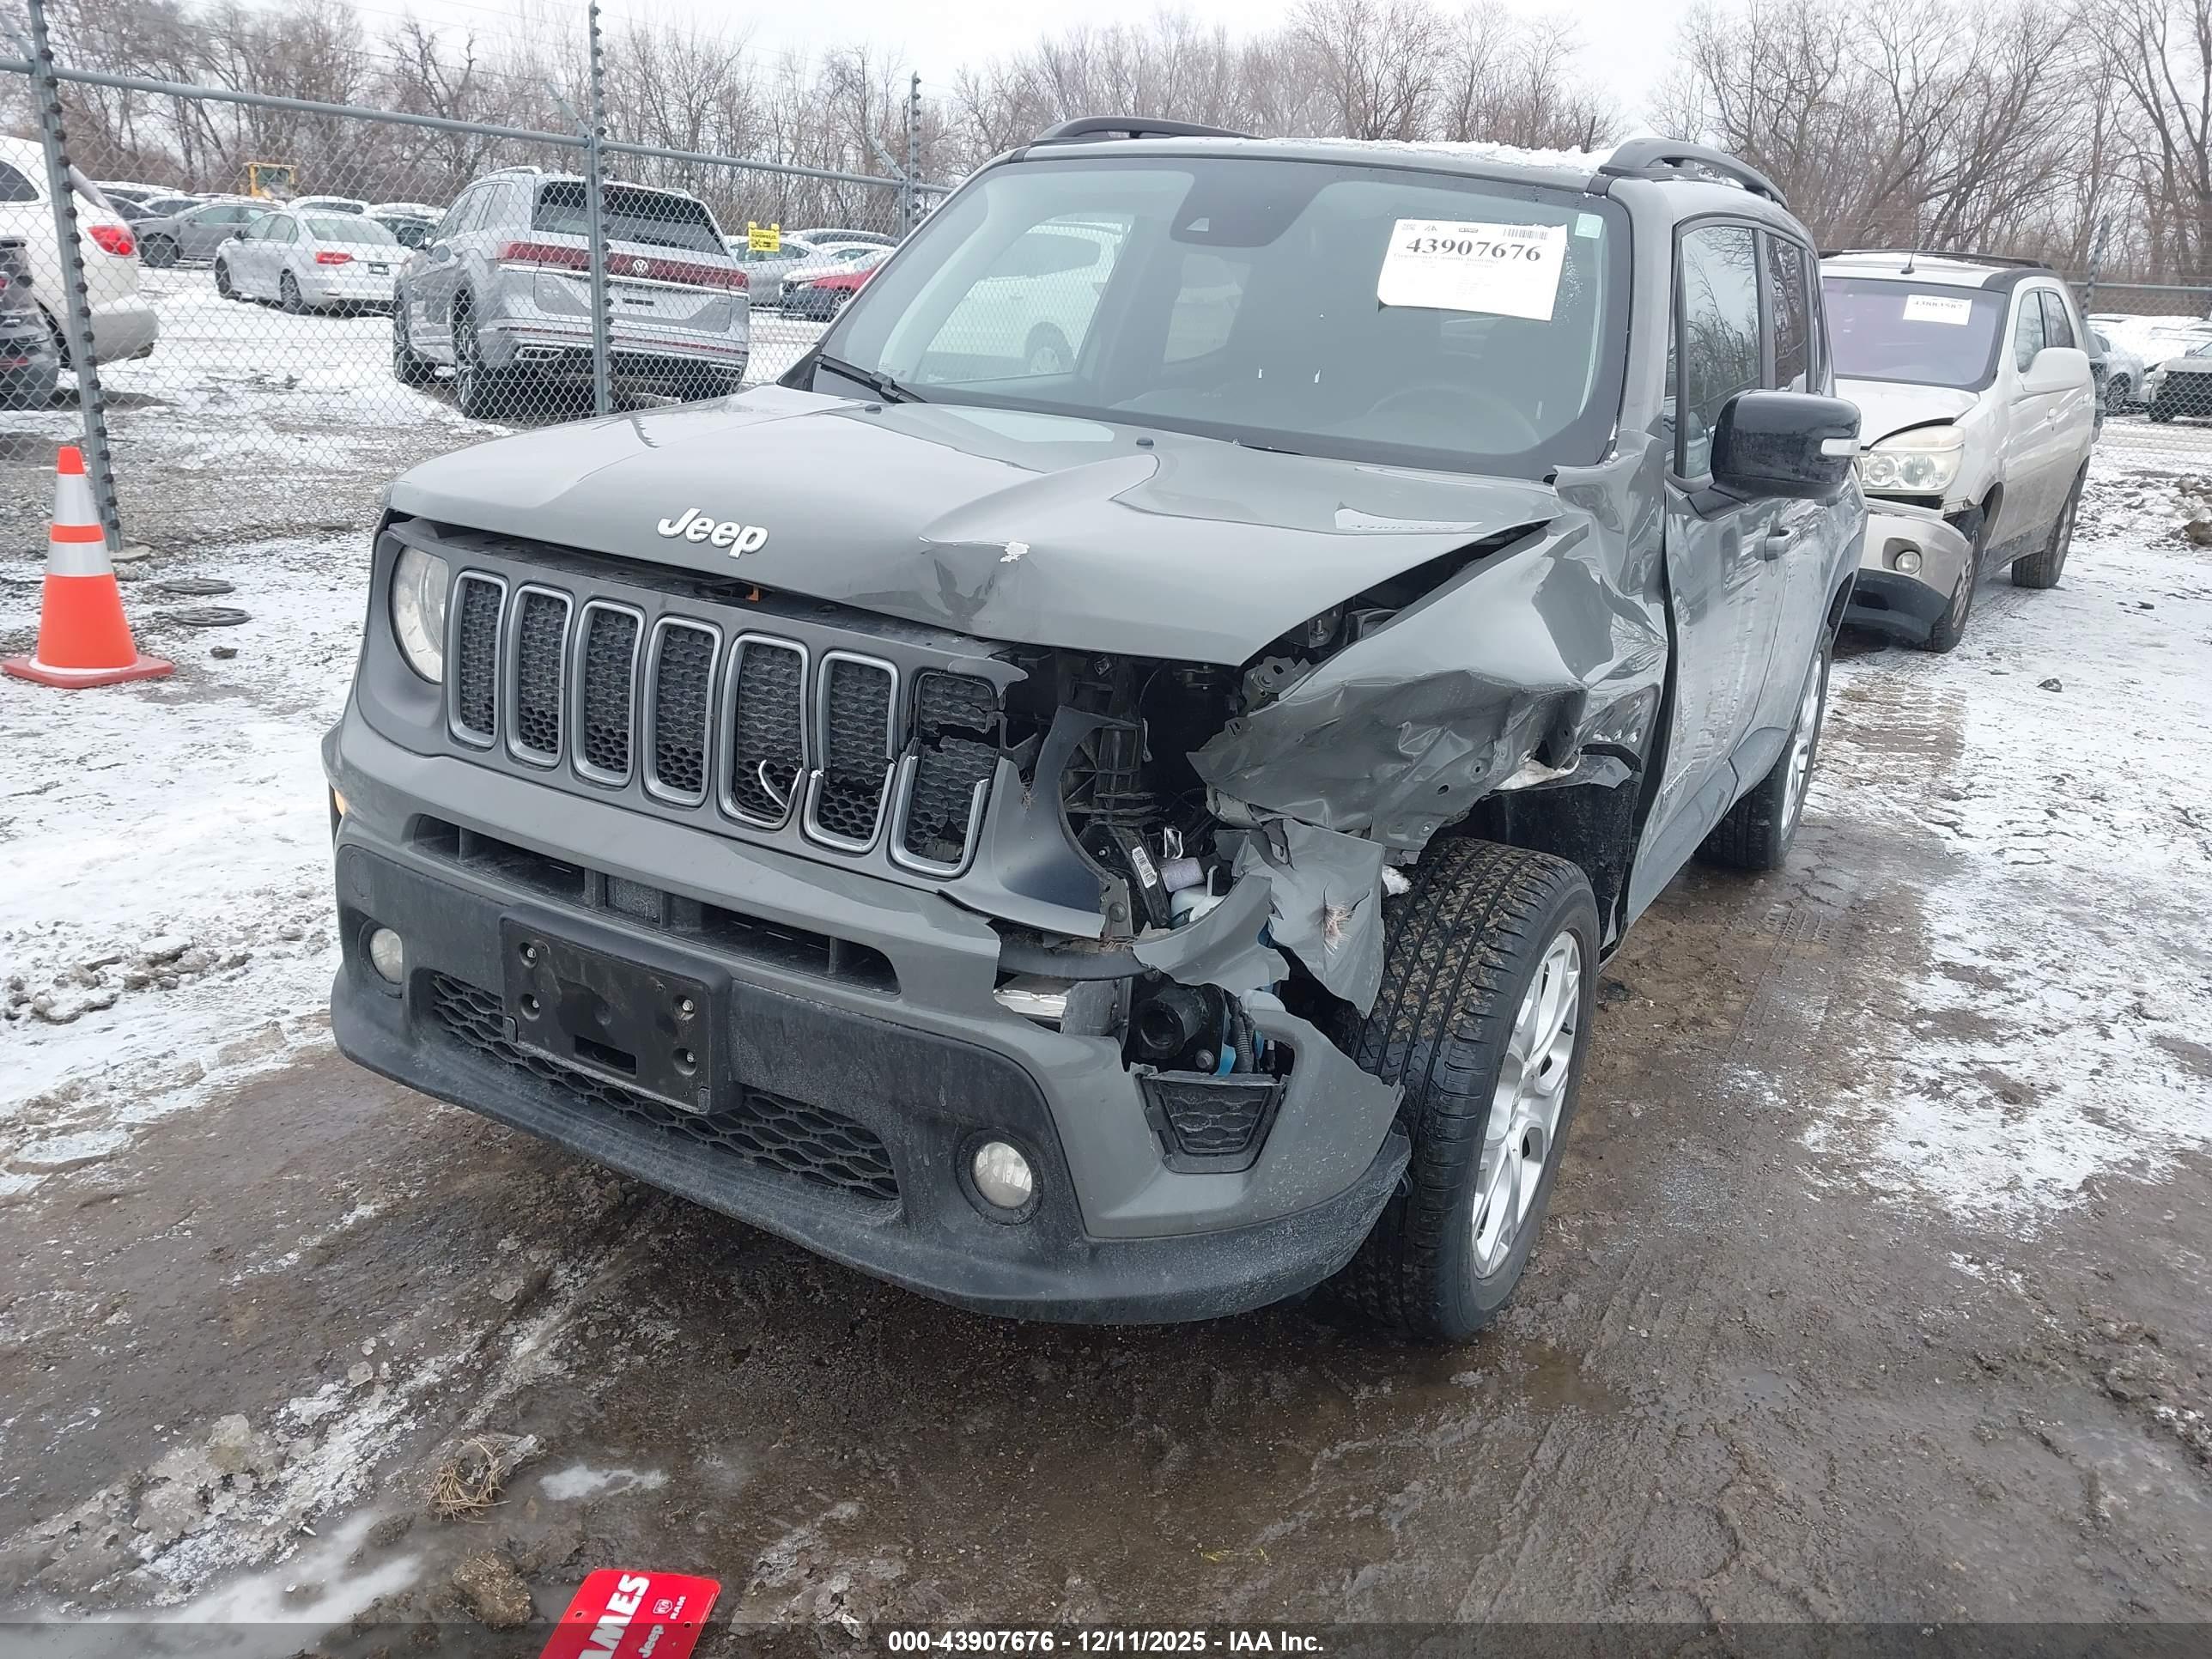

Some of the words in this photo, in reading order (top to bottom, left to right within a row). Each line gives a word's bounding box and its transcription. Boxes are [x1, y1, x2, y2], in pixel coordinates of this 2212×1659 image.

[1406, 237, 1542, 262] 43907676
[657, 507, 769, 559] Jeep
[669, 1595, 687, 1620] RAM
[638, 1624, 665, 1659] Jeep
